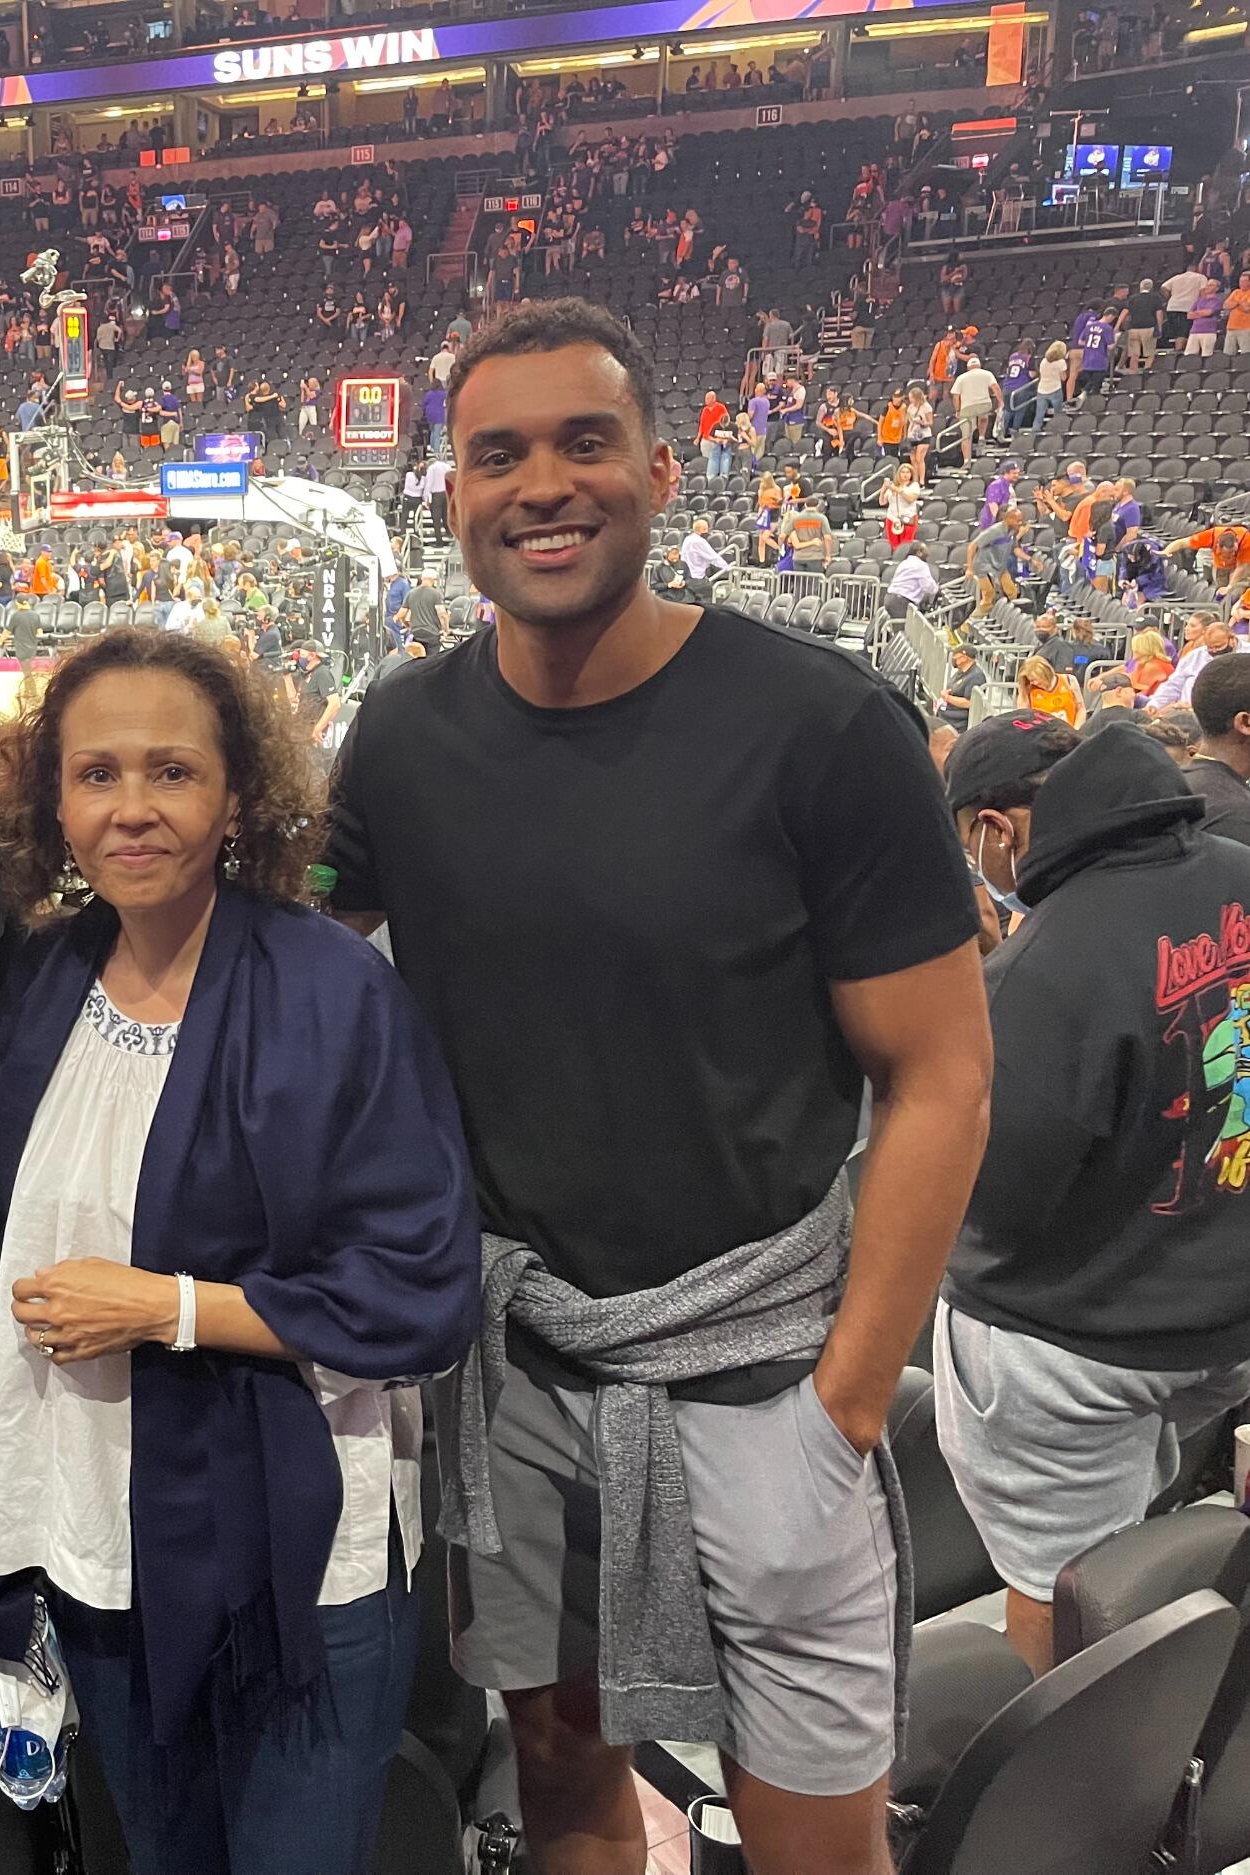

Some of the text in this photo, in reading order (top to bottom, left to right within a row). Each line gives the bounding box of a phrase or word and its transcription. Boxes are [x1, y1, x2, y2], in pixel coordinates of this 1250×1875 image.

[213, 27, 436, 83] SUNS WIN
[762, 109, 778, 122] 116
[355, 147, 371, 160] 115
[4, 181, 18, 192] 114
[1086, 333, 1102, 349] 13
[321, 568, 336, 647] NBA TV
